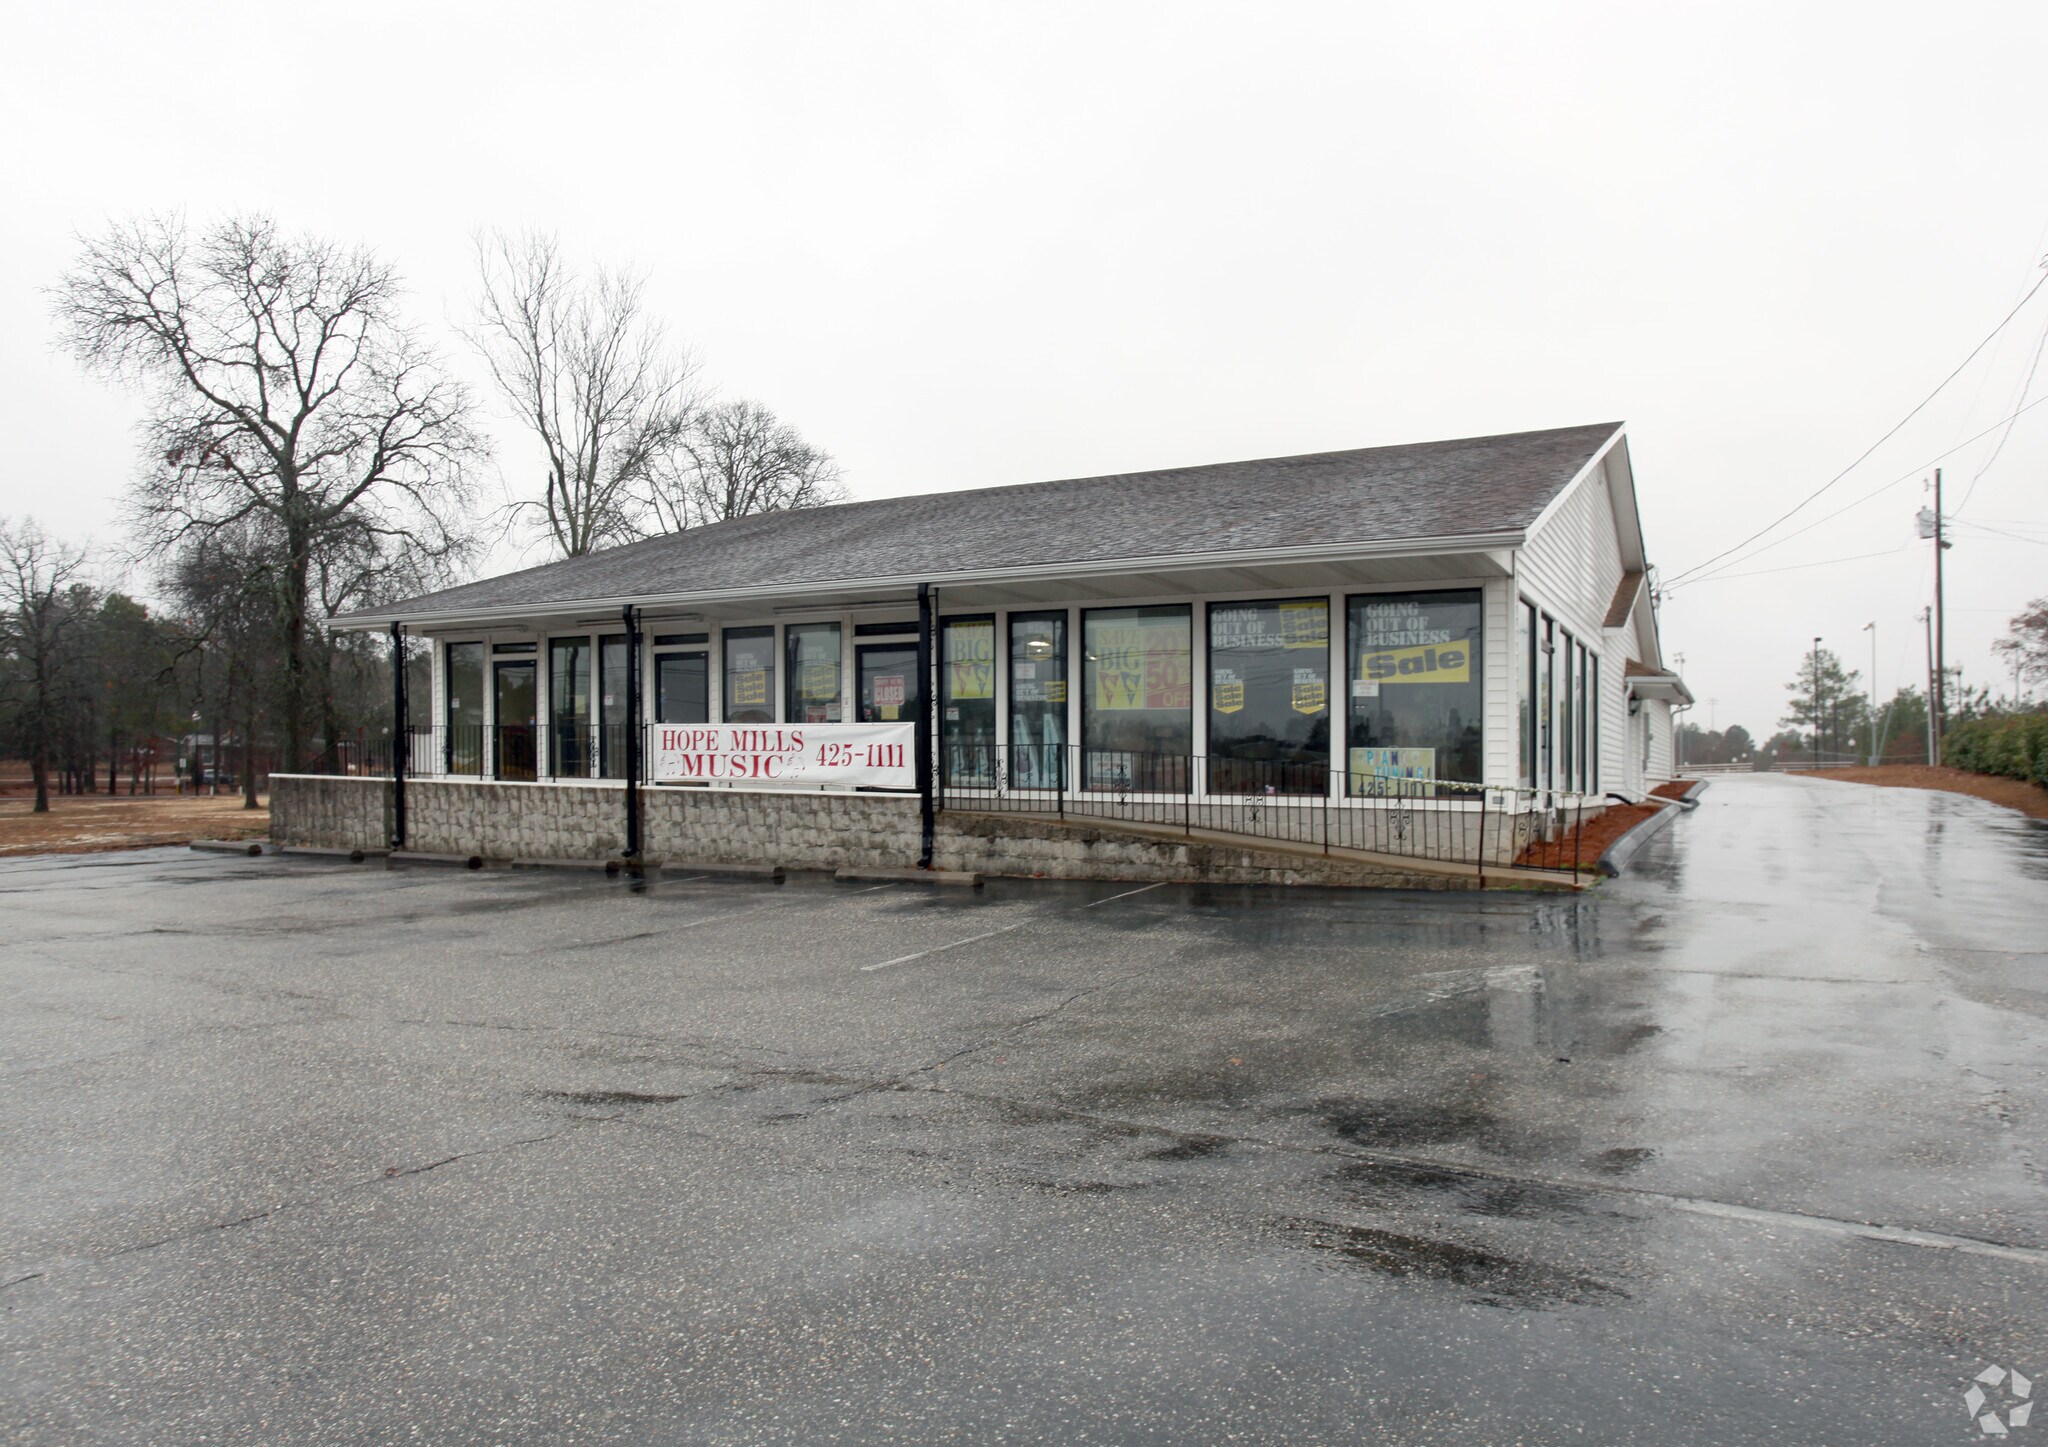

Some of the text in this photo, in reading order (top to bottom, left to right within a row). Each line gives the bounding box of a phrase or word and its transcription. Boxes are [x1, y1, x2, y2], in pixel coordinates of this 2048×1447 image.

[1211, 608, 1258, 622] GOING
[1366, 602, 1419, 618] GOING
[1211, 621, 1266, 635] OUT OF
[1366, 616, 1429, 632] OUT OF
[1098, 629, 1142, 646] SAVE
[1211, 633, 1284, 648] BUSINESS
[1366, 630, 1450, 646] BUSINESS
[954, 639, 991, 662] BIG
[1100, 646, 1140, 671] BIG
[1366, 648, 1465, 679] Sale
[736, 672, 765, 685] Sale
[736, 681, 765, 693] Sale
[874, 686, 904, 702] CLOSED
[1215, 685, 1242, 694] Sale
[736, 690, 765, 703] Sale
[1162, 692, 1190, 707] OFF
[1215, 692, 1242, 701] Sale
[1215, 700, 1243, 709] Sale
[662, 729, 805, 752] HOPE MILLS
[815, 742, 906, 768] 425-1111
[680, 753, 784, 779] MUSIC
